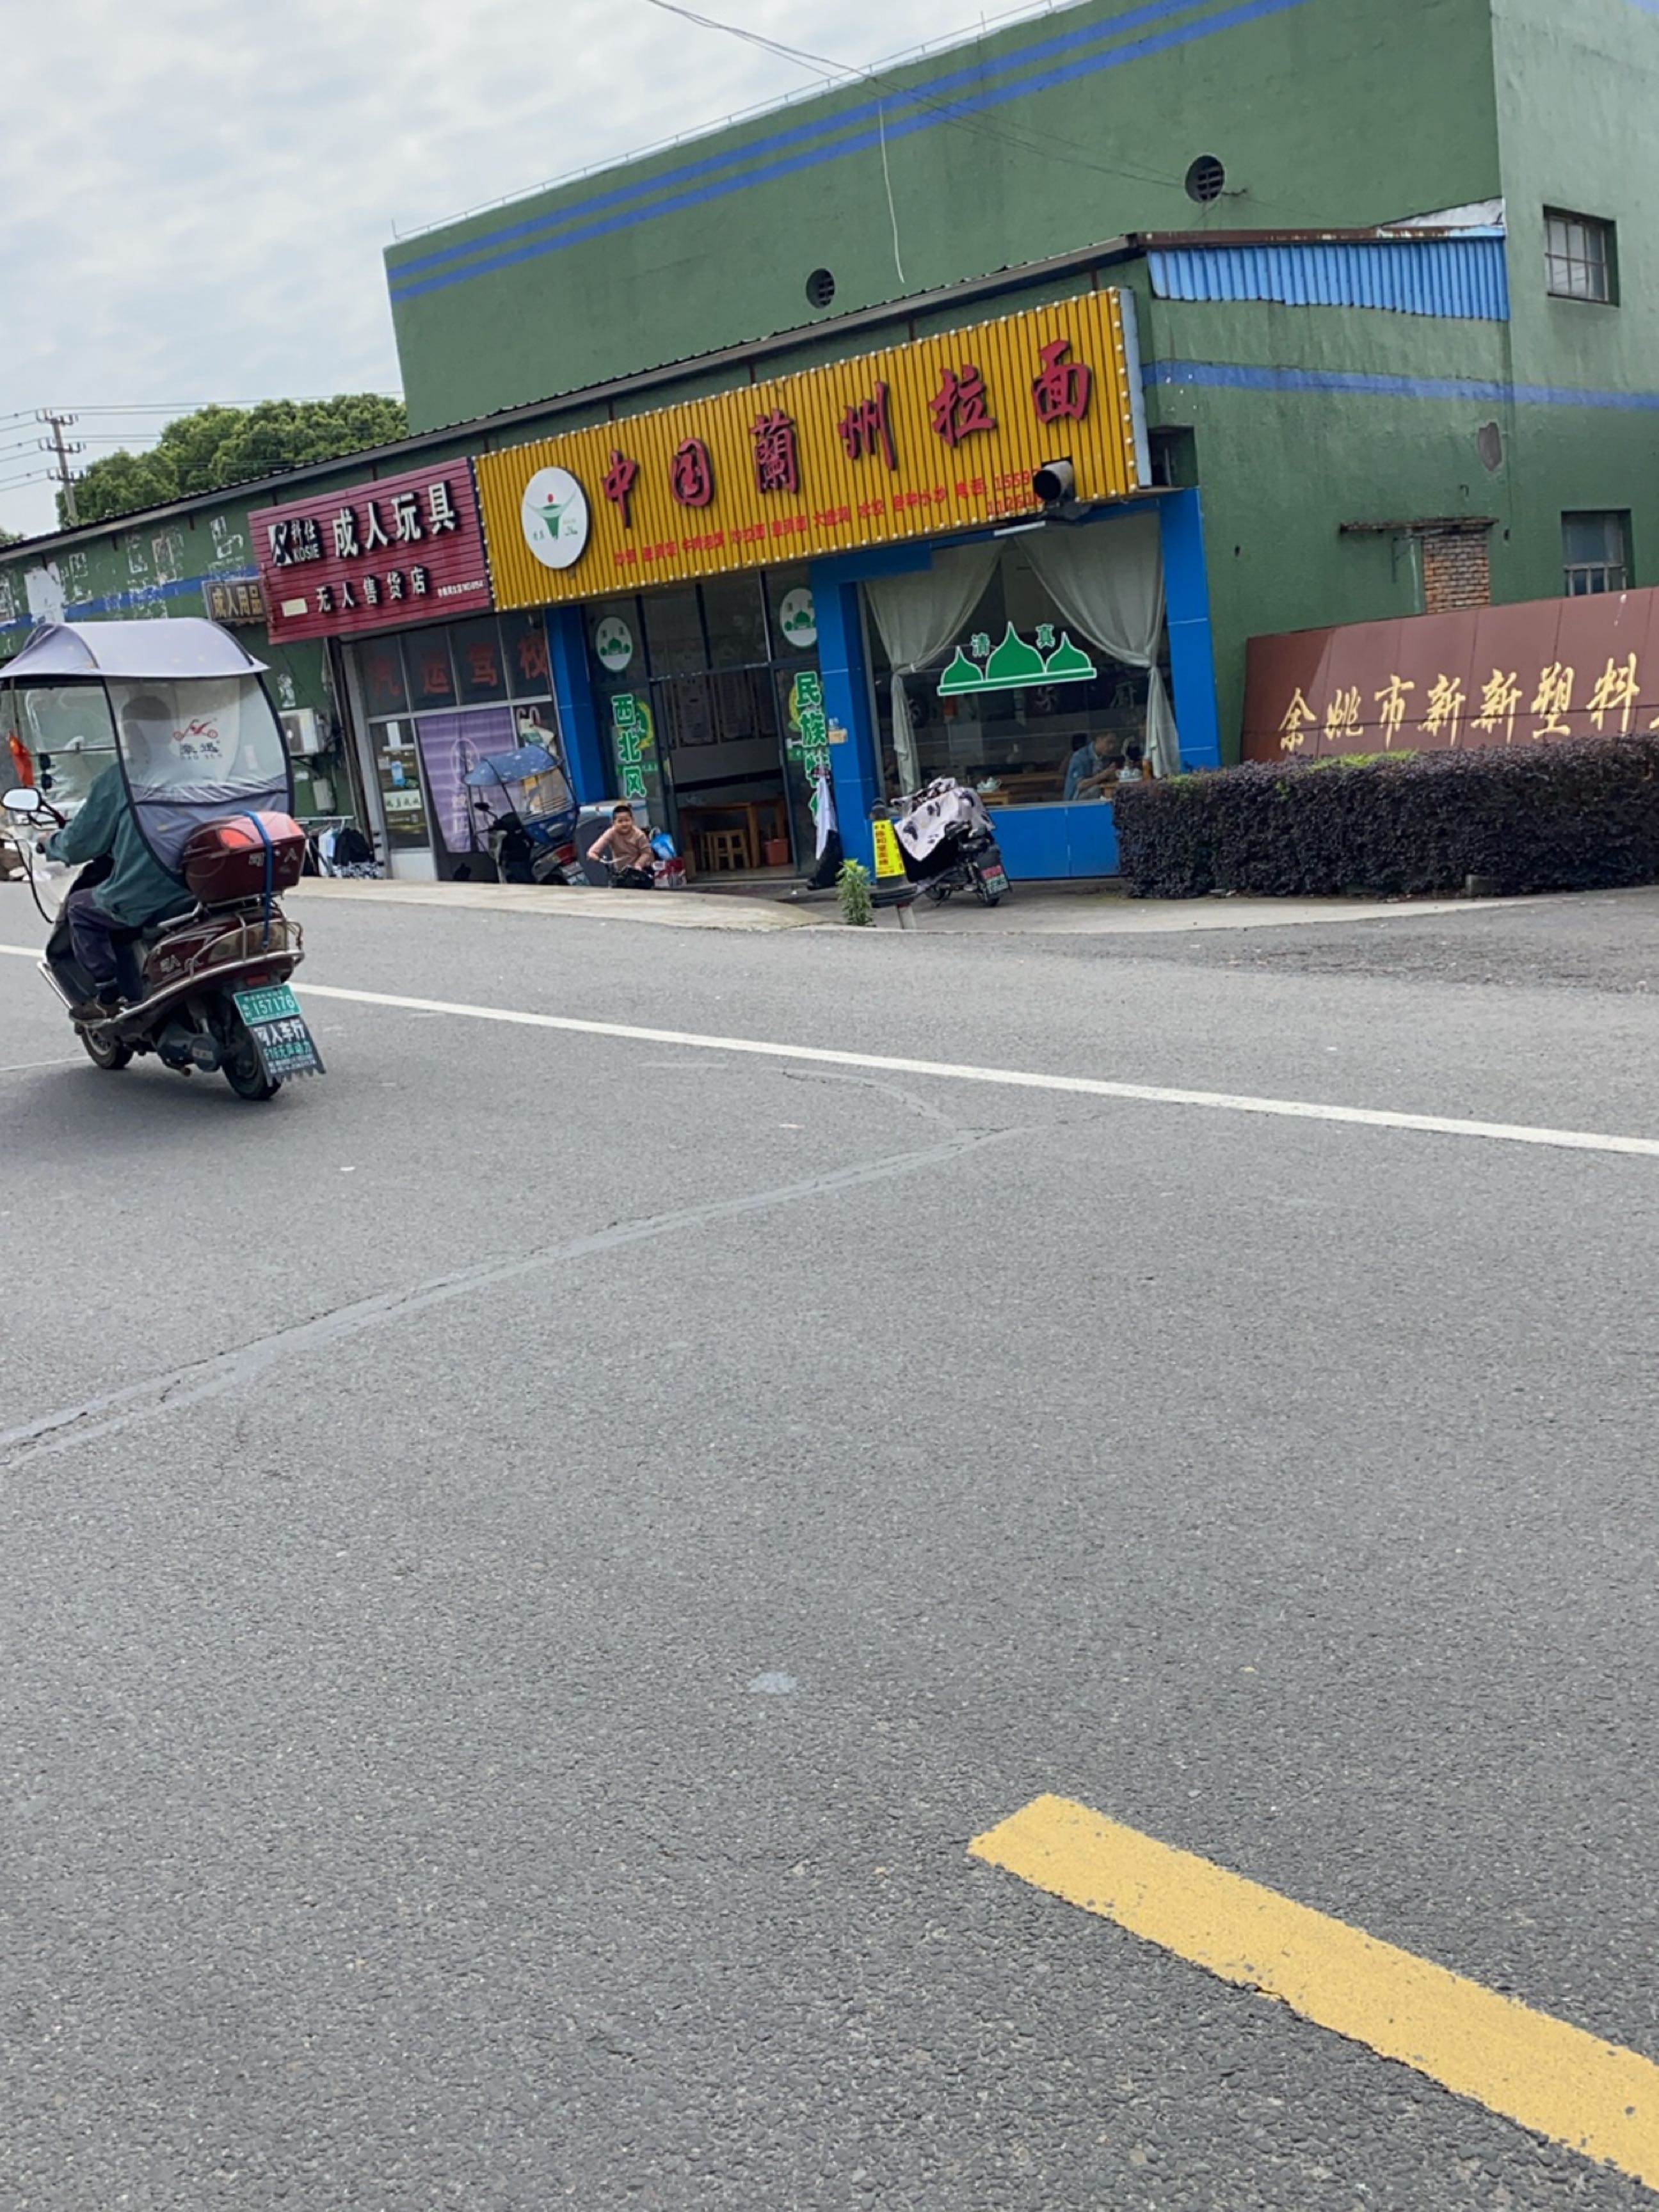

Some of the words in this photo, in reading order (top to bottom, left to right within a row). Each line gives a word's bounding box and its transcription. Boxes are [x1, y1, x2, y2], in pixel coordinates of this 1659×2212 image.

[332, 480, 456, 559] 成人玩具
[291, 542, 321, 563] KOSIE
[212, 585, 263, 618] 成人用品
[315, 565, 428, 614] 无人售货店
[1278, 652, 1659, 751] 余姚市新新塑料
[611, 693, 647, 799] 西北风
[252, 995, 296, 1015] 157176
